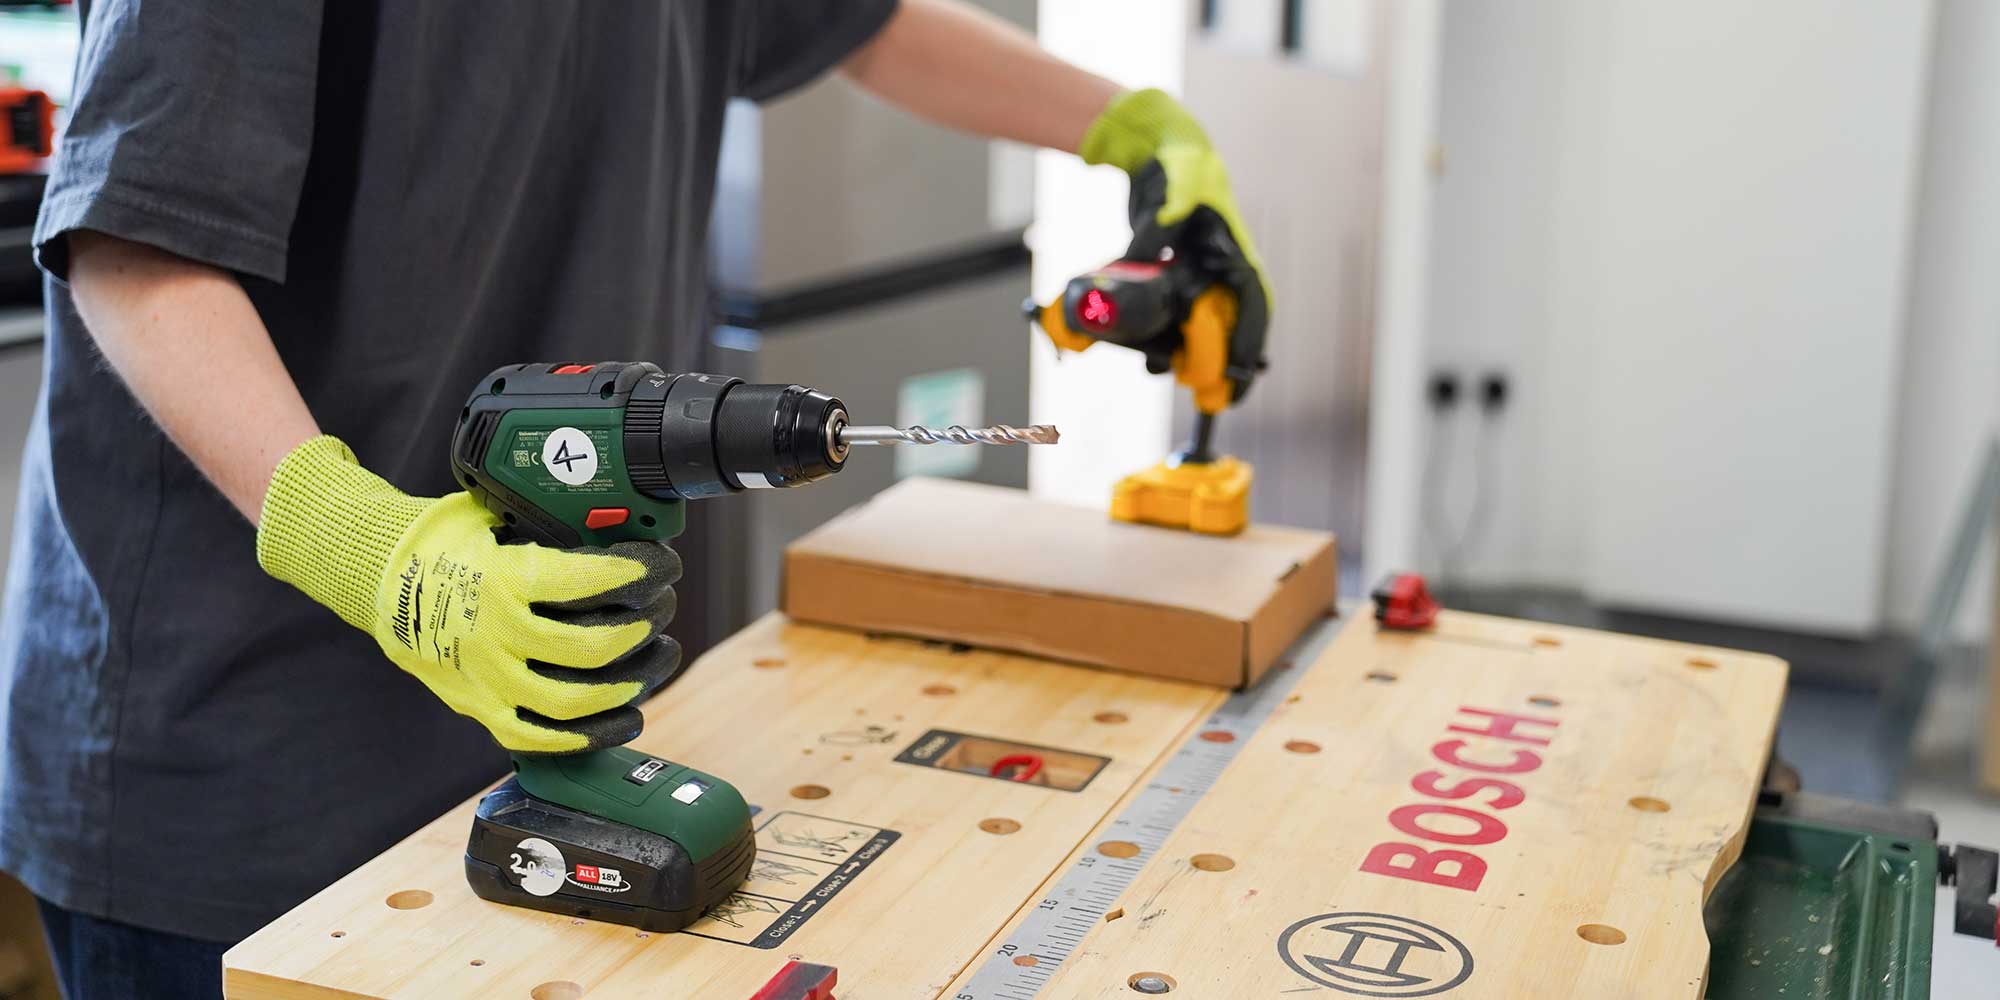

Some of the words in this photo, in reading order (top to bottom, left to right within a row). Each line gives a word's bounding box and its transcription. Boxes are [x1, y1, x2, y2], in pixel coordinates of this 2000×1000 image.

[552, 439, 588, 473] 4
[392, 557, 420, 650] Milwaukee
[1359, 705, 1560, 892] BOSCH
[1078, 856, 1097, 868] 10
[579, 869, 597, 879] ALL
[601, 872, 618, 882] 18V
[769, 914, 803, 939] Close-1
[815, 874, 848, 898] Close-2
[1039, 898, 1060, 911] 15
[996, 943, 1019, 958] 20
